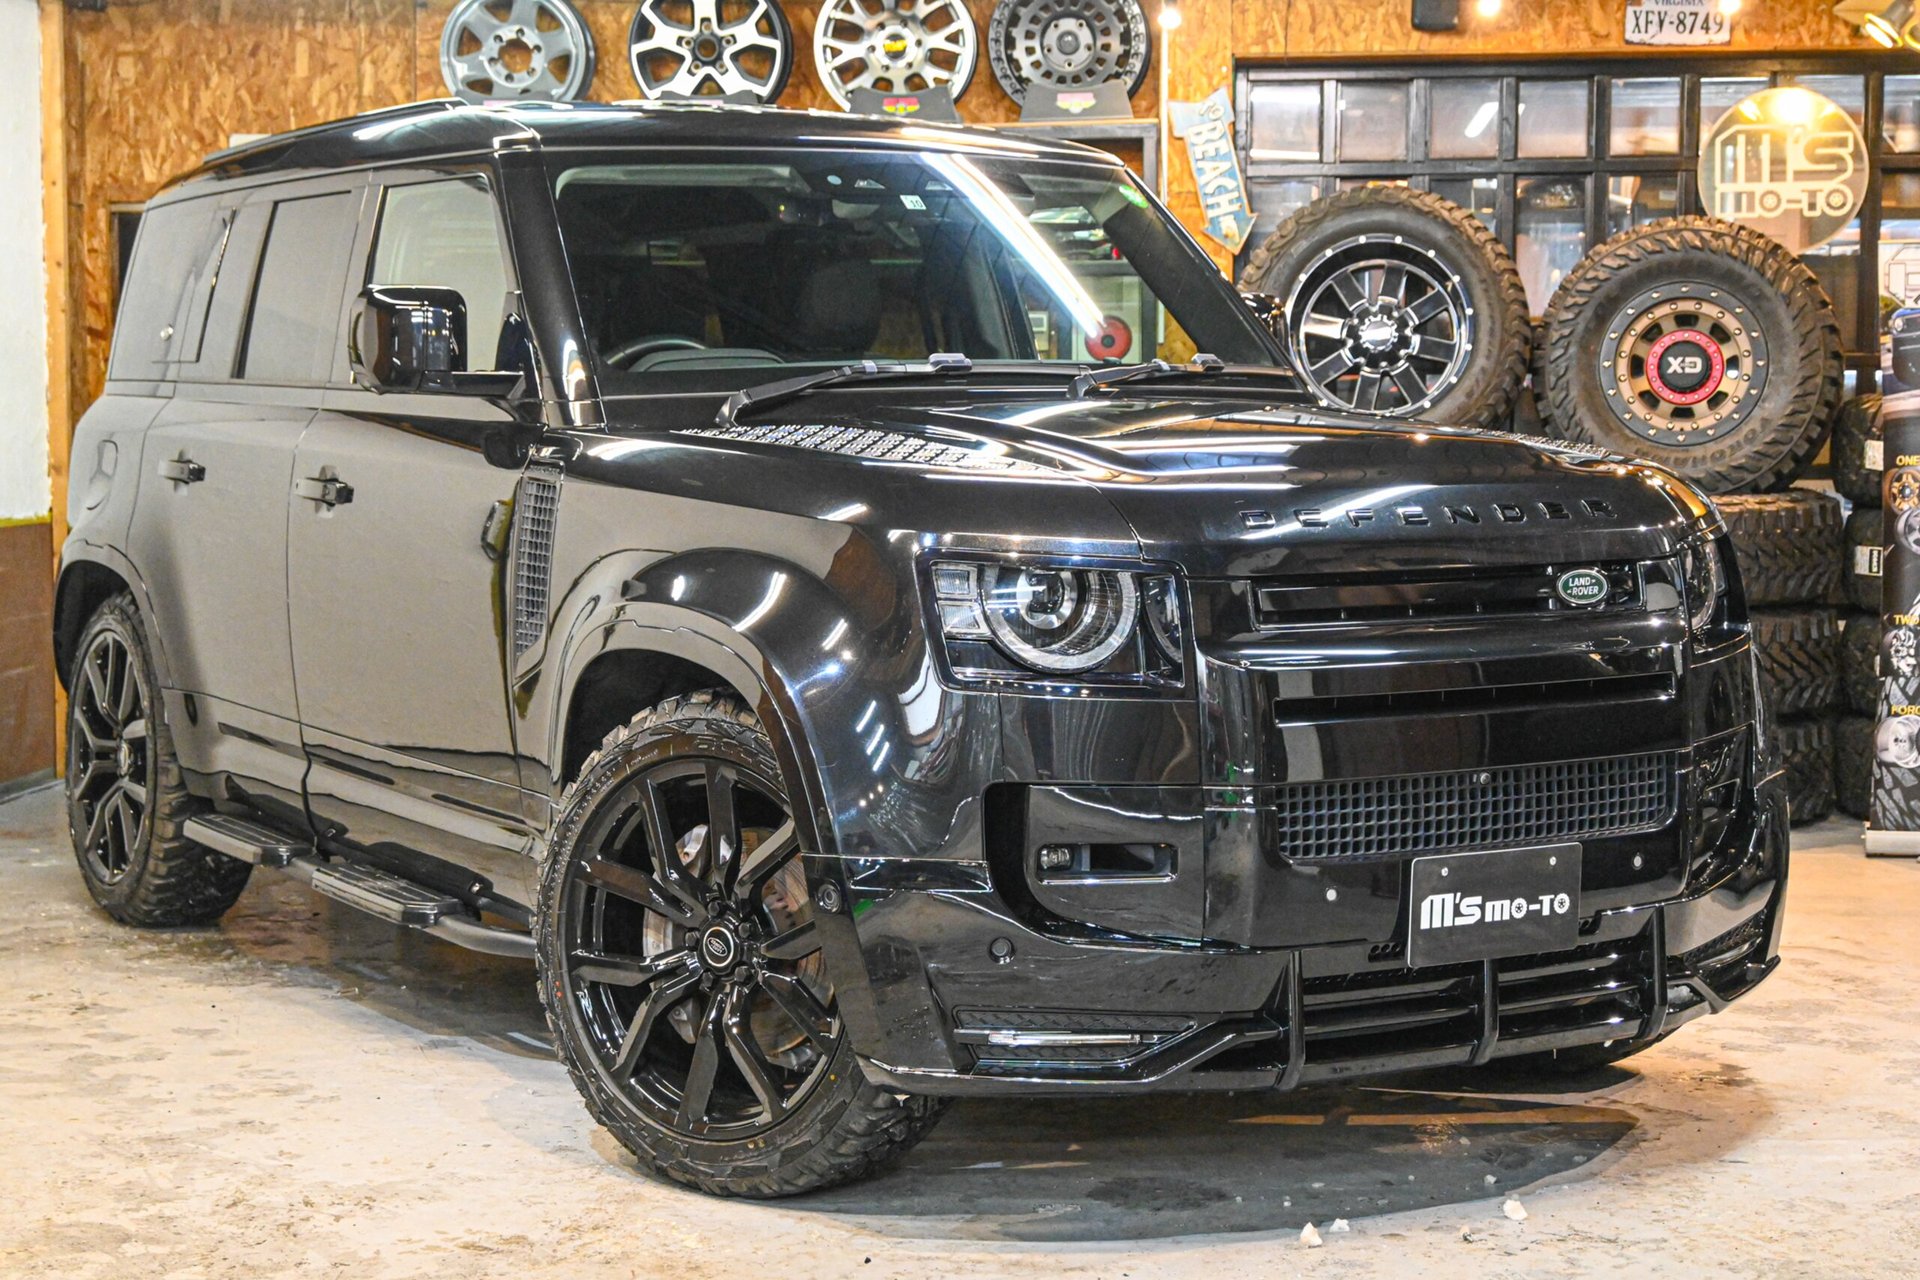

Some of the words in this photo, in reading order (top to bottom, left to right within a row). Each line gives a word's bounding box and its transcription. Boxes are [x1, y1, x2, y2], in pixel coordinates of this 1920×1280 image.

[1632, 10, 1724, 34] XFV-8749
[1187, 119, 1242, 218] BEACH
[1715, 183, 1854, 218] MO-TO
[1666, 356, 1702, 374] XD
[1238, 499, 1618, 530] DEFENDER
[1420, 892, 1482, 930] M'S
